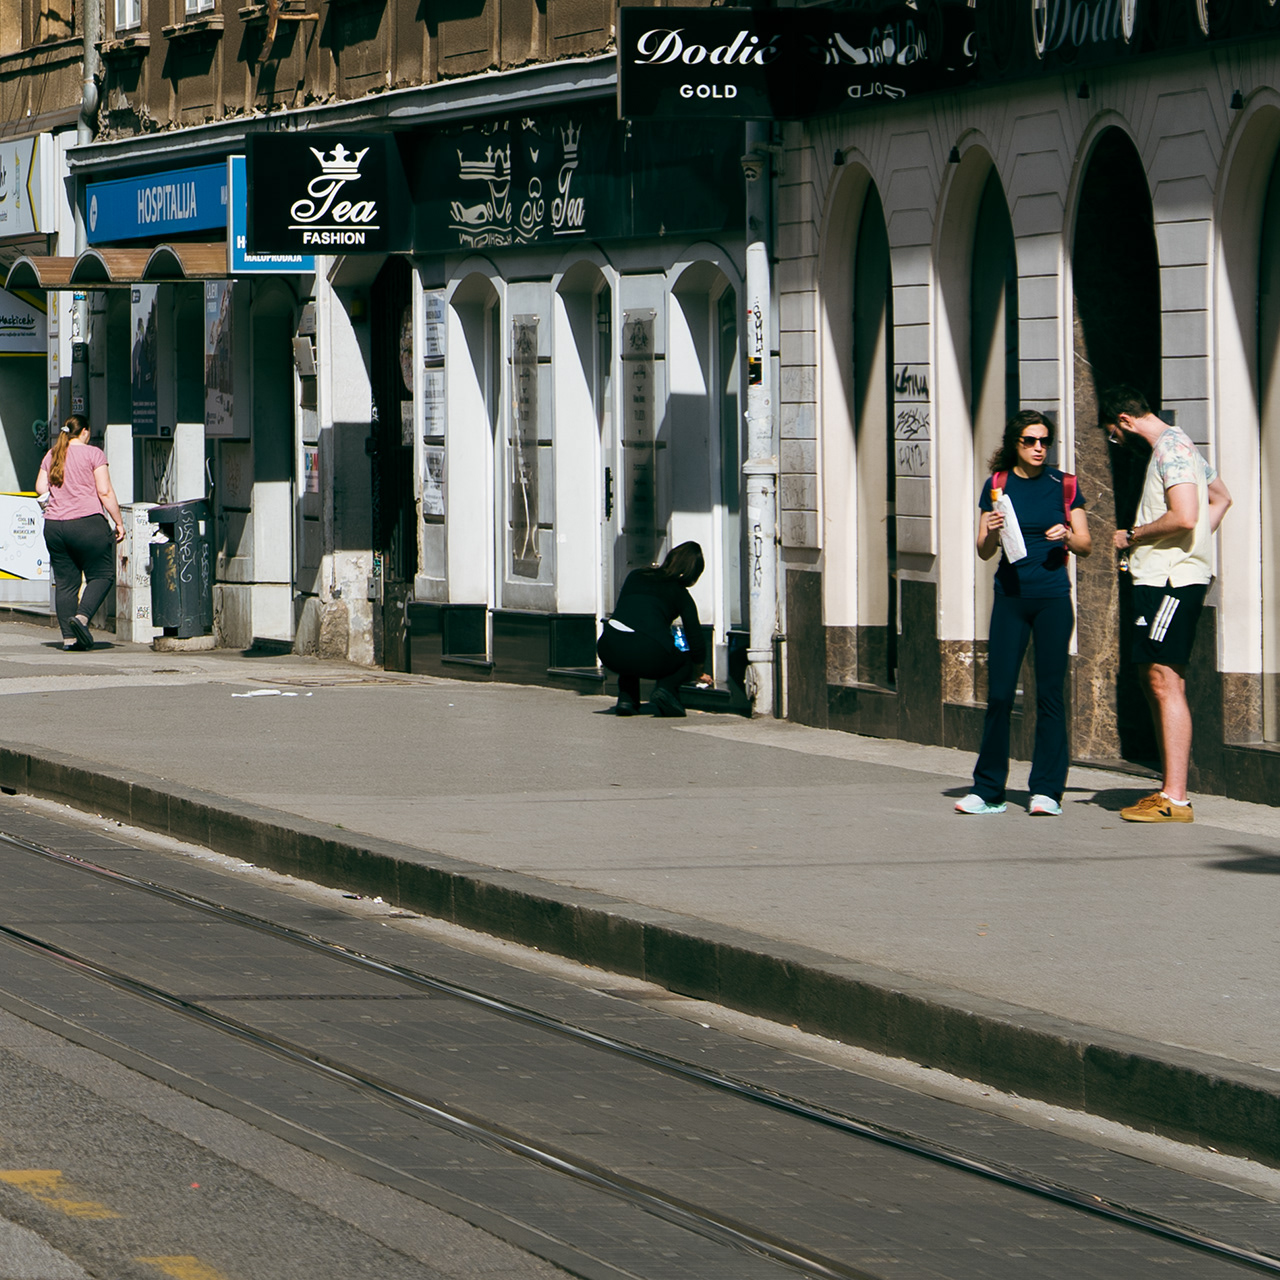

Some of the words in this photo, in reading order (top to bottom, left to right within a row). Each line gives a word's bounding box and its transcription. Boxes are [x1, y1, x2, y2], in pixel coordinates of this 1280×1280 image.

[633, 27, 785, 66] Dodić
[679, 84, 738, 99] GOLD
[137, 181, 198, 225] HOSPITALIJA
[290, 173, 378, 224] Tea
[303, 231, 366, 245] FASHION
